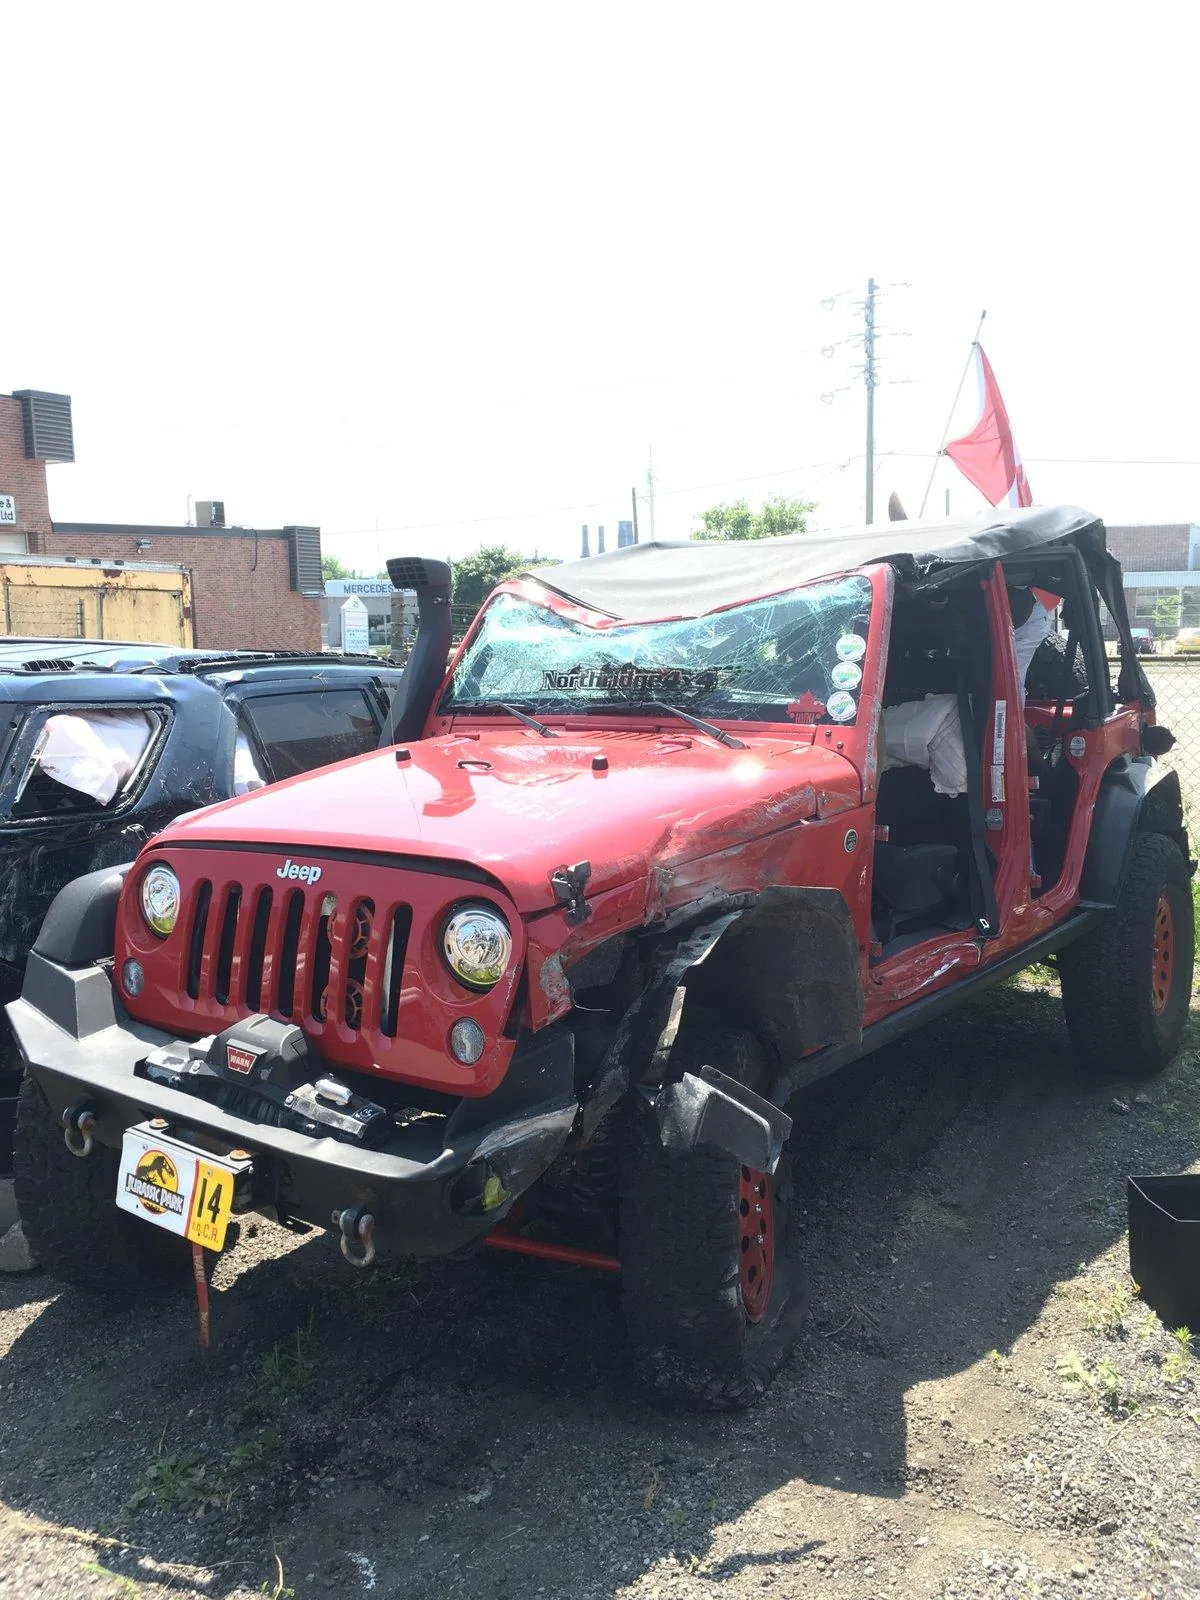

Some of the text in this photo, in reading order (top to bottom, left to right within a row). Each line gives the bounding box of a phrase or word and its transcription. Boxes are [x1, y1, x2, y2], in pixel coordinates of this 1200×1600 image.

[0, 510, 14, 520] Ltd
[343, 584, 394, 594] MERCEDES
[276, 859, 322, 885] Jeep
[229, 1054, 250, 1068] WARN
[125, 1174, 183, 1213] JURASSIC PARK
[196, 1178, 223, 1224] 14
